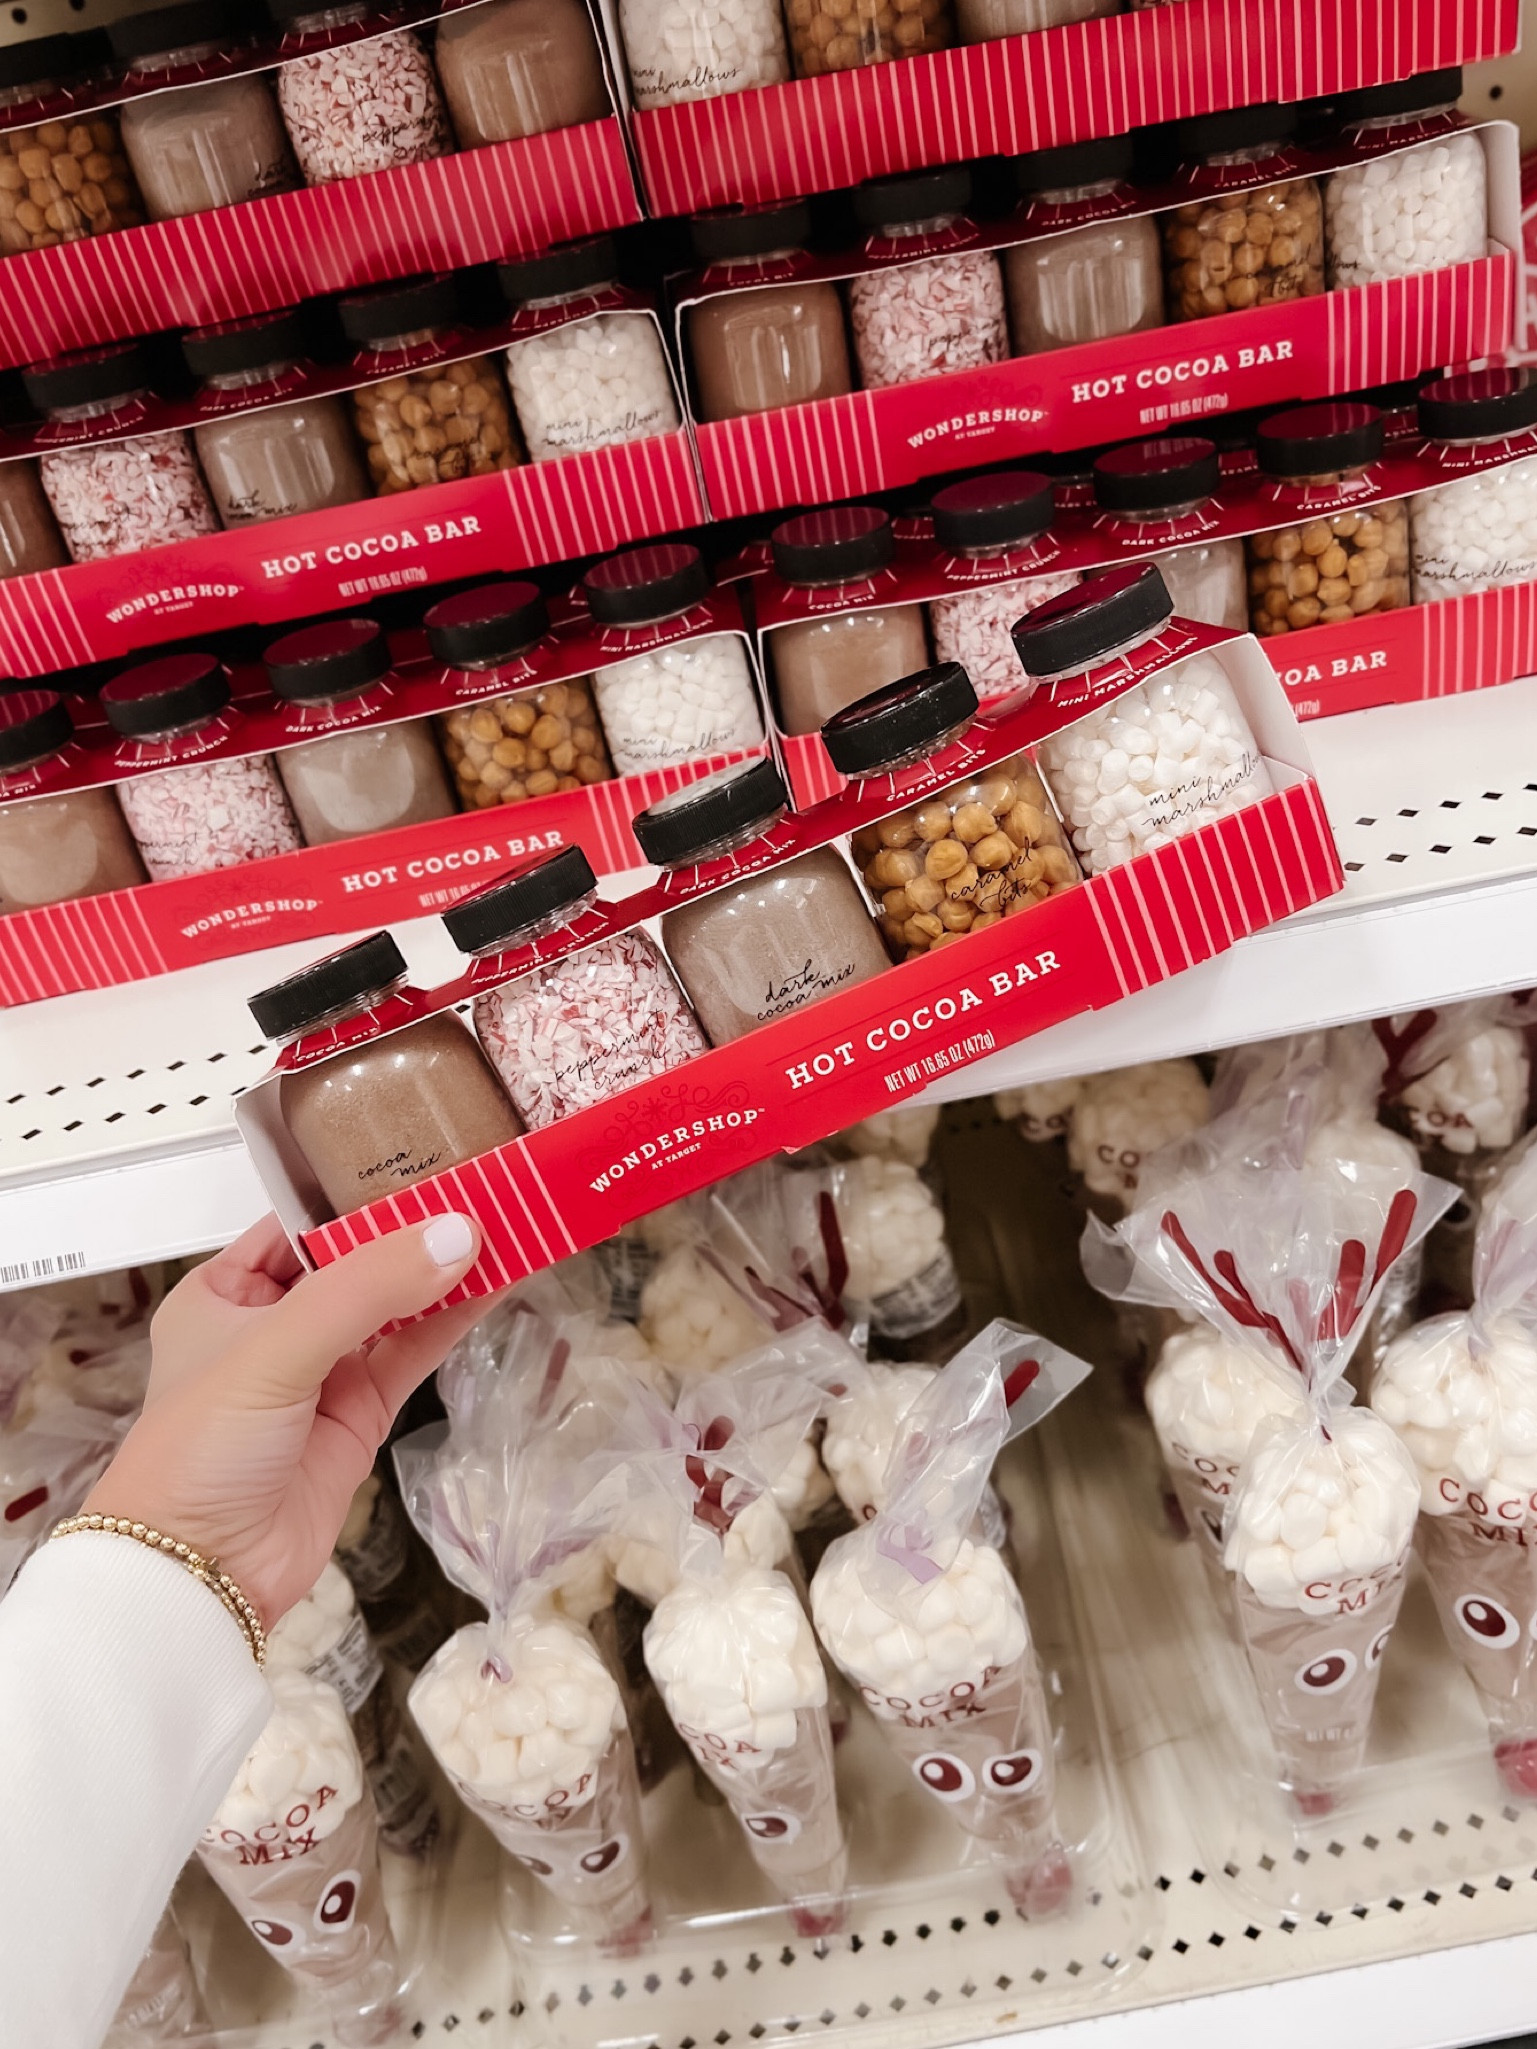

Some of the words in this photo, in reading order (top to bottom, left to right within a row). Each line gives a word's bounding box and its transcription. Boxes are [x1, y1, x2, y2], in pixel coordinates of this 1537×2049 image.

[1071, 375, 1128, 403] HOT
[1136, 355, 1229, 390] COCOA
[1238, 340, 1293, 368] BAR
[261, 551, 317, 578] HOT
[325, 530, 419, 564] COCOA
[424, 516, 482, 544] BAR
[1056, 693, 1089, 708] MINI
[1094, 636, 1198, 697] MARSHMALLOWS
[1331, 650, 1387, 677] BAR
[886, 768, 955, 801] CARAMEL
[958, 748, 986, 770] BITS
[1149, 776, 1202, 807] mini
[341, 866, 398, 893] HOT
[406, 845, 501, 879] COCOA
[507, 830, 565, 858] BAR
[721, 856, 771, 880] COCOA
[757, 989, 812, 1021] cocoa
[811, 963, 855, 990] mix
[765, 958, 820, 1002] dark
[785, 1042, 855, 1090] HOT
[866, 988, 983, 1052] COCOA
[989, 950, 1061, 997] BAR
[884, 1073, 906, 1093] NET
[902, 1064, 923, 1087] WT
[921, 1049, 950, 1076] 16.65
[947, 1044, 964, 1064] OZ
[962, 1029, 997, 1060] (472g)
[358, 1149, 412, 1180] cocoa
[391, 1151, 442, 1178] mix
[651, 1161, 664, 1170] AT
[664, 1143, 701, 1164] TARGET
[236, 1826, 320, 1865] MIX
